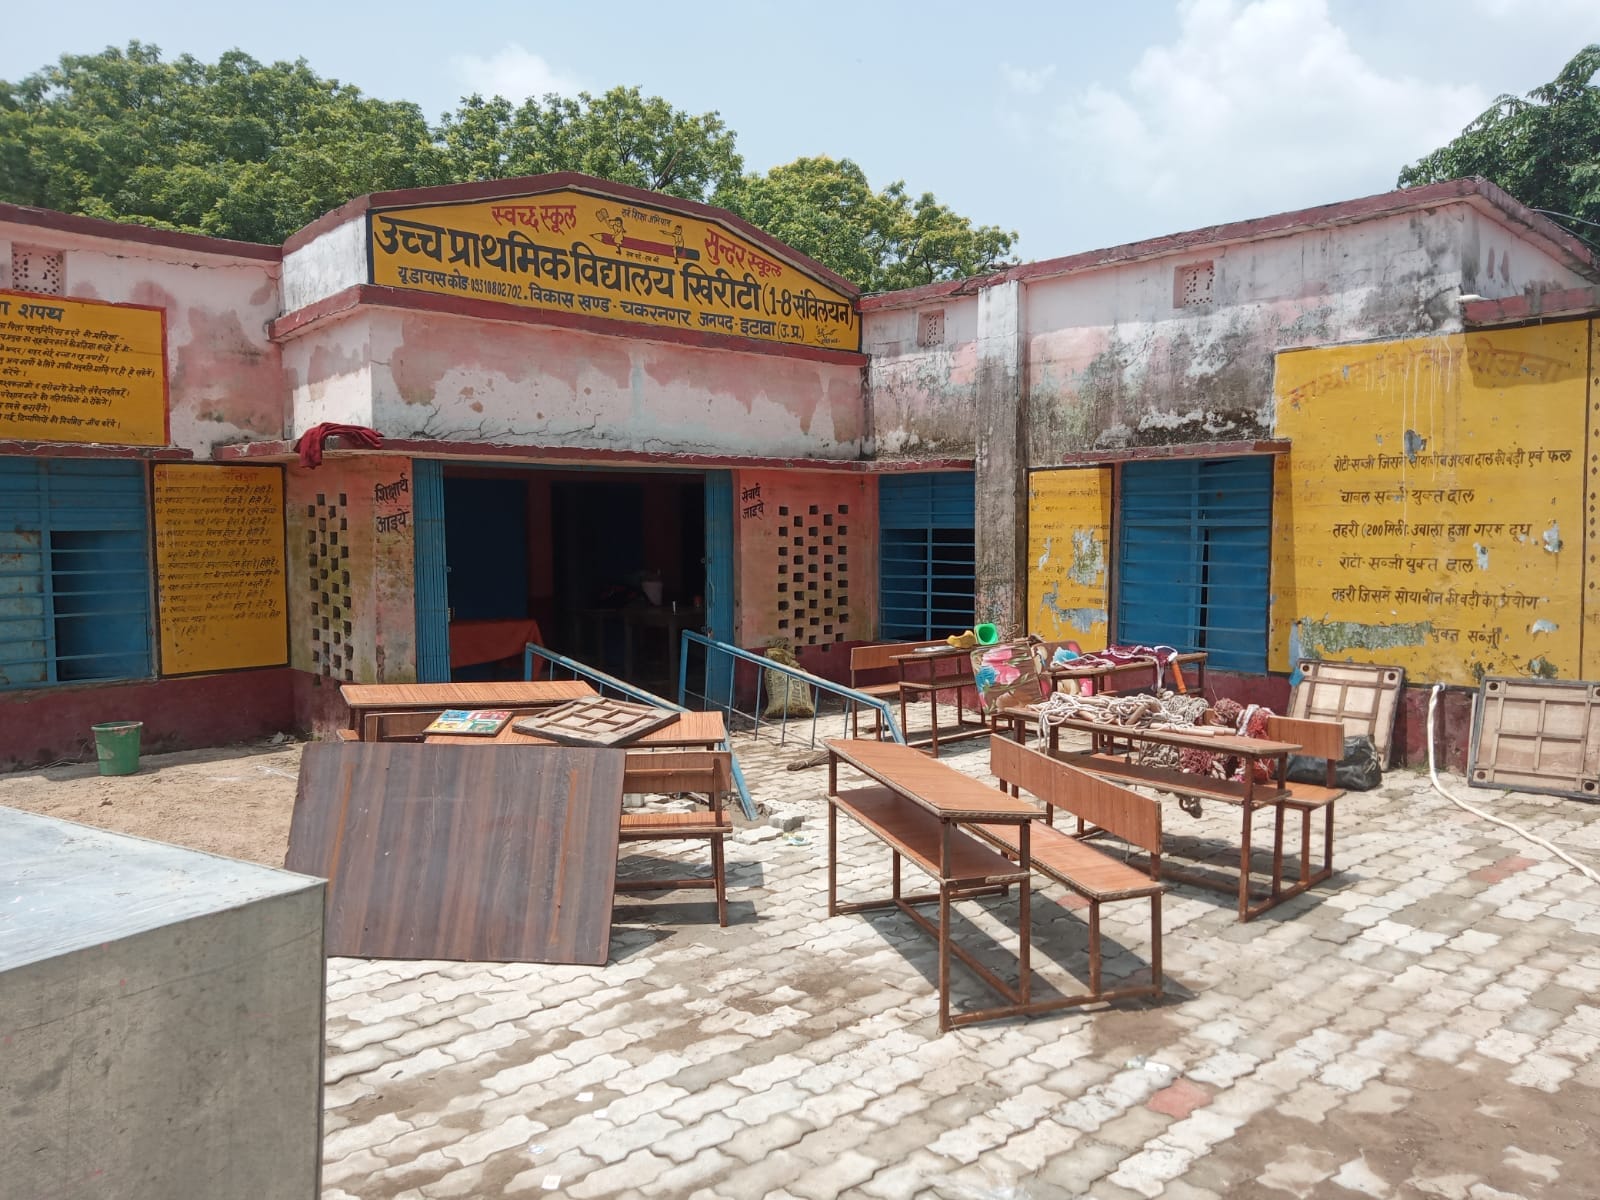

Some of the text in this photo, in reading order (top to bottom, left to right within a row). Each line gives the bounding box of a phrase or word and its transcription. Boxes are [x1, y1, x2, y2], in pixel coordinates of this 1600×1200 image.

[491, 205, 577, 235] स्वच्छ स्कूल
[374, 216, 446, 262] उच्च
[447, 228, 571, 281] प्राथमिक
[570, 241, 675, 298] विद्यालय
[704, 228, 782, 279] सुन्दर स्कूल
[18, 304, 65, 323] शपथ
[528, 282, 574, 309] विकास
[578, 294, 611, 313] खण्ड
[620, 300, 691, 326] चकरनगर
[698, 311, 734, 332] जनपद
[739, 319, 777, 337] इटावा
[1475, 452, 1494, 468] दाल
[1528, 447, 1544, 468] एवं
[1547, 449, 1573, 463] फल
[1340, 490, 1370, 504] चावल
[1447, 489, 1475, 505] दाल
[1332, 519, 1360, 539] तहरी
[1473, 523, 1505, 538] गरम
[1509, 523, 1533, 543] दूध
[1405, 557, 1439, 574] युक्त
[1446, 558, 1474, 574] दाल
[1331, 585, 1356, 603] तहरी
